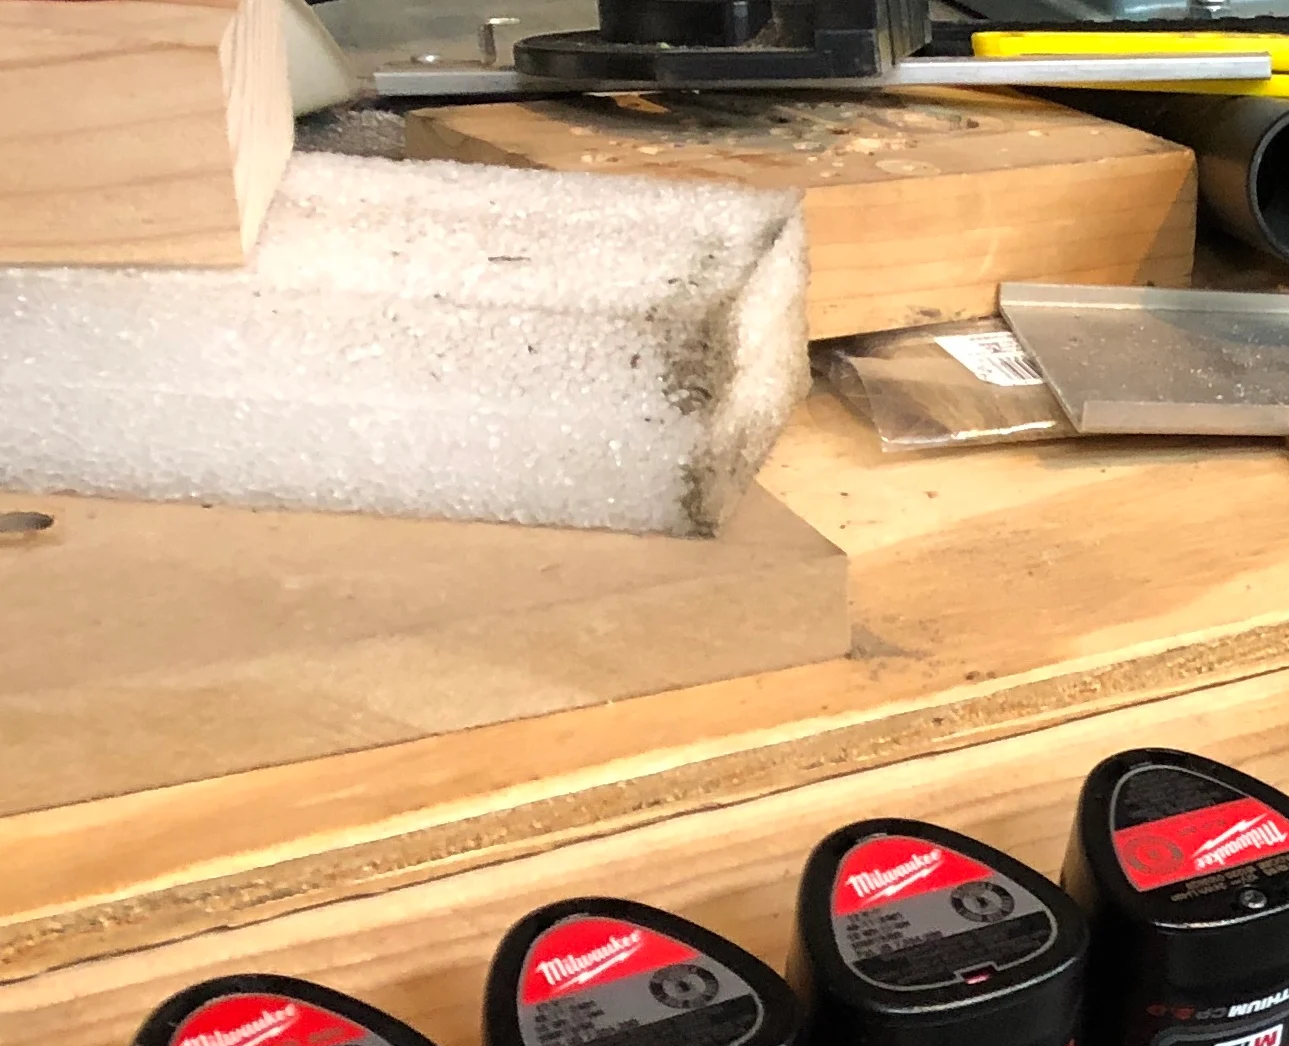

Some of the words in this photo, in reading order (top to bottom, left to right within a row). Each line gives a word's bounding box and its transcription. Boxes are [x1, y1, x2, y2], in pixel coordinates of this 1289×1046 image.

[1193, 819, 1289, 871] Milwaukee
[845, 848, 942, 898] Milwaukee
[535, 929, 641, 986] Milwaukee
